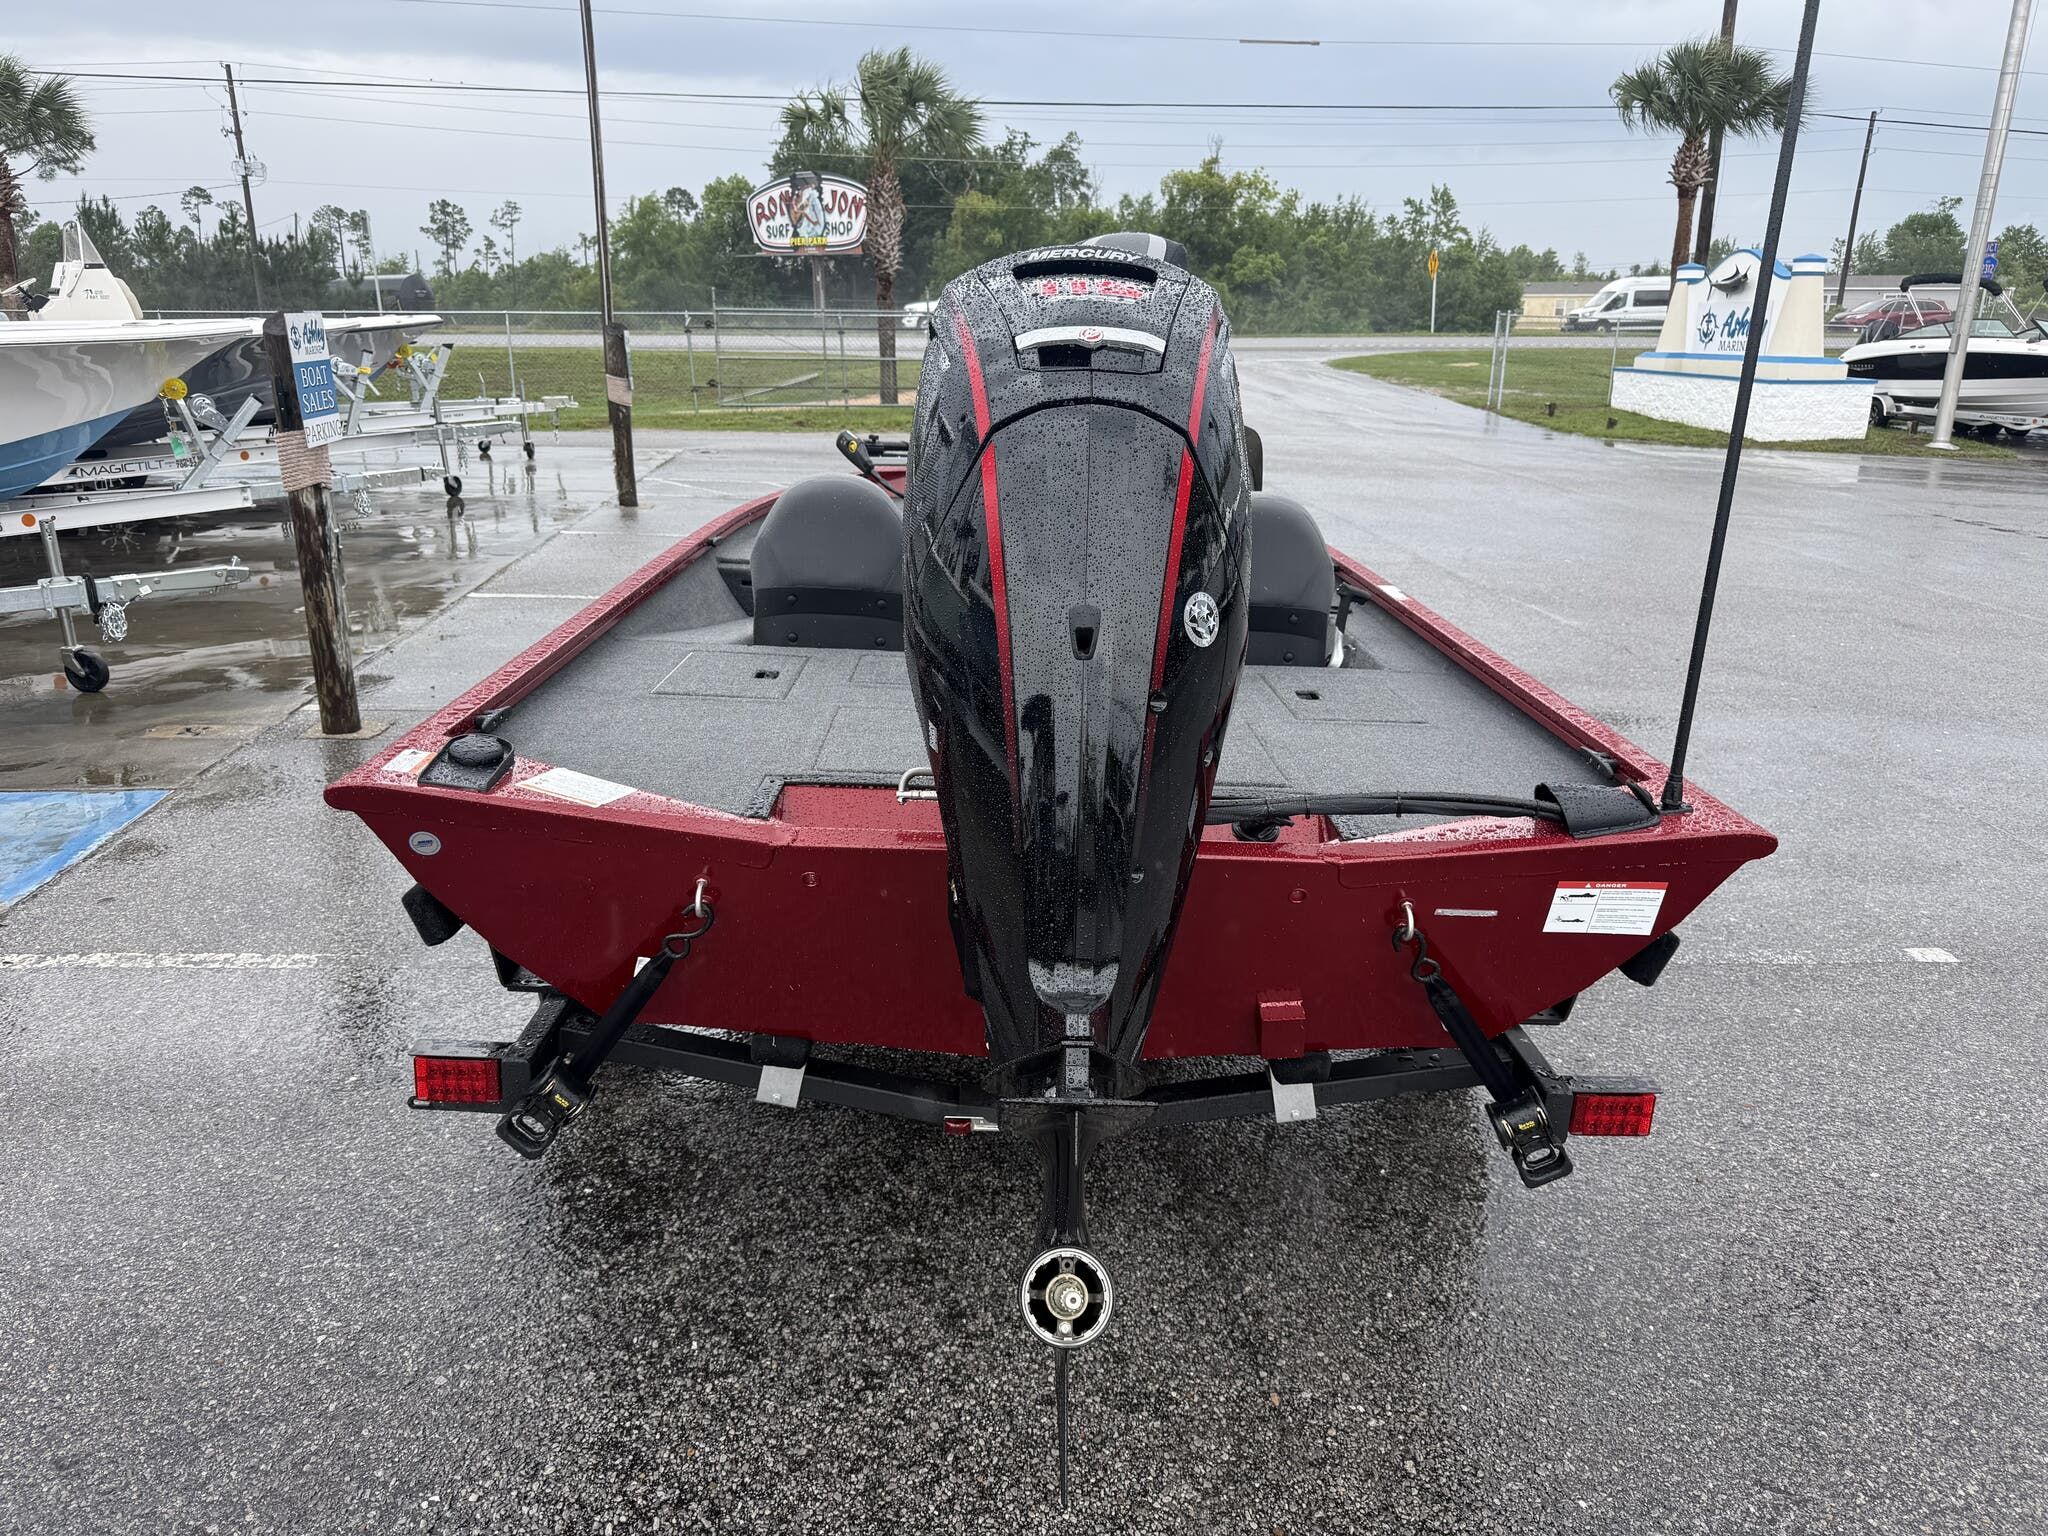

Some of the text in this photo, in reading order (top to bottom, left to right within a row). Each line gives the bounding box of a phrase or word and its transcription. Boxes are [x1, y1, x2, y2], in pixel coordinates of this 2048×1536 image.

[755, 190, 865, 226] RON JON
[766, 221, 853, 239] SURF SHOP
[1028, 248, 1141, 262] MERCURY
[303, 319, 325, 351] Ashley
[300, 365, 328, 388] BOAT
[302, 389, 335, 413] SALES
[305, 419, 342, 443] PARKING
[80, 459, 165, 477] MAGICTILT
